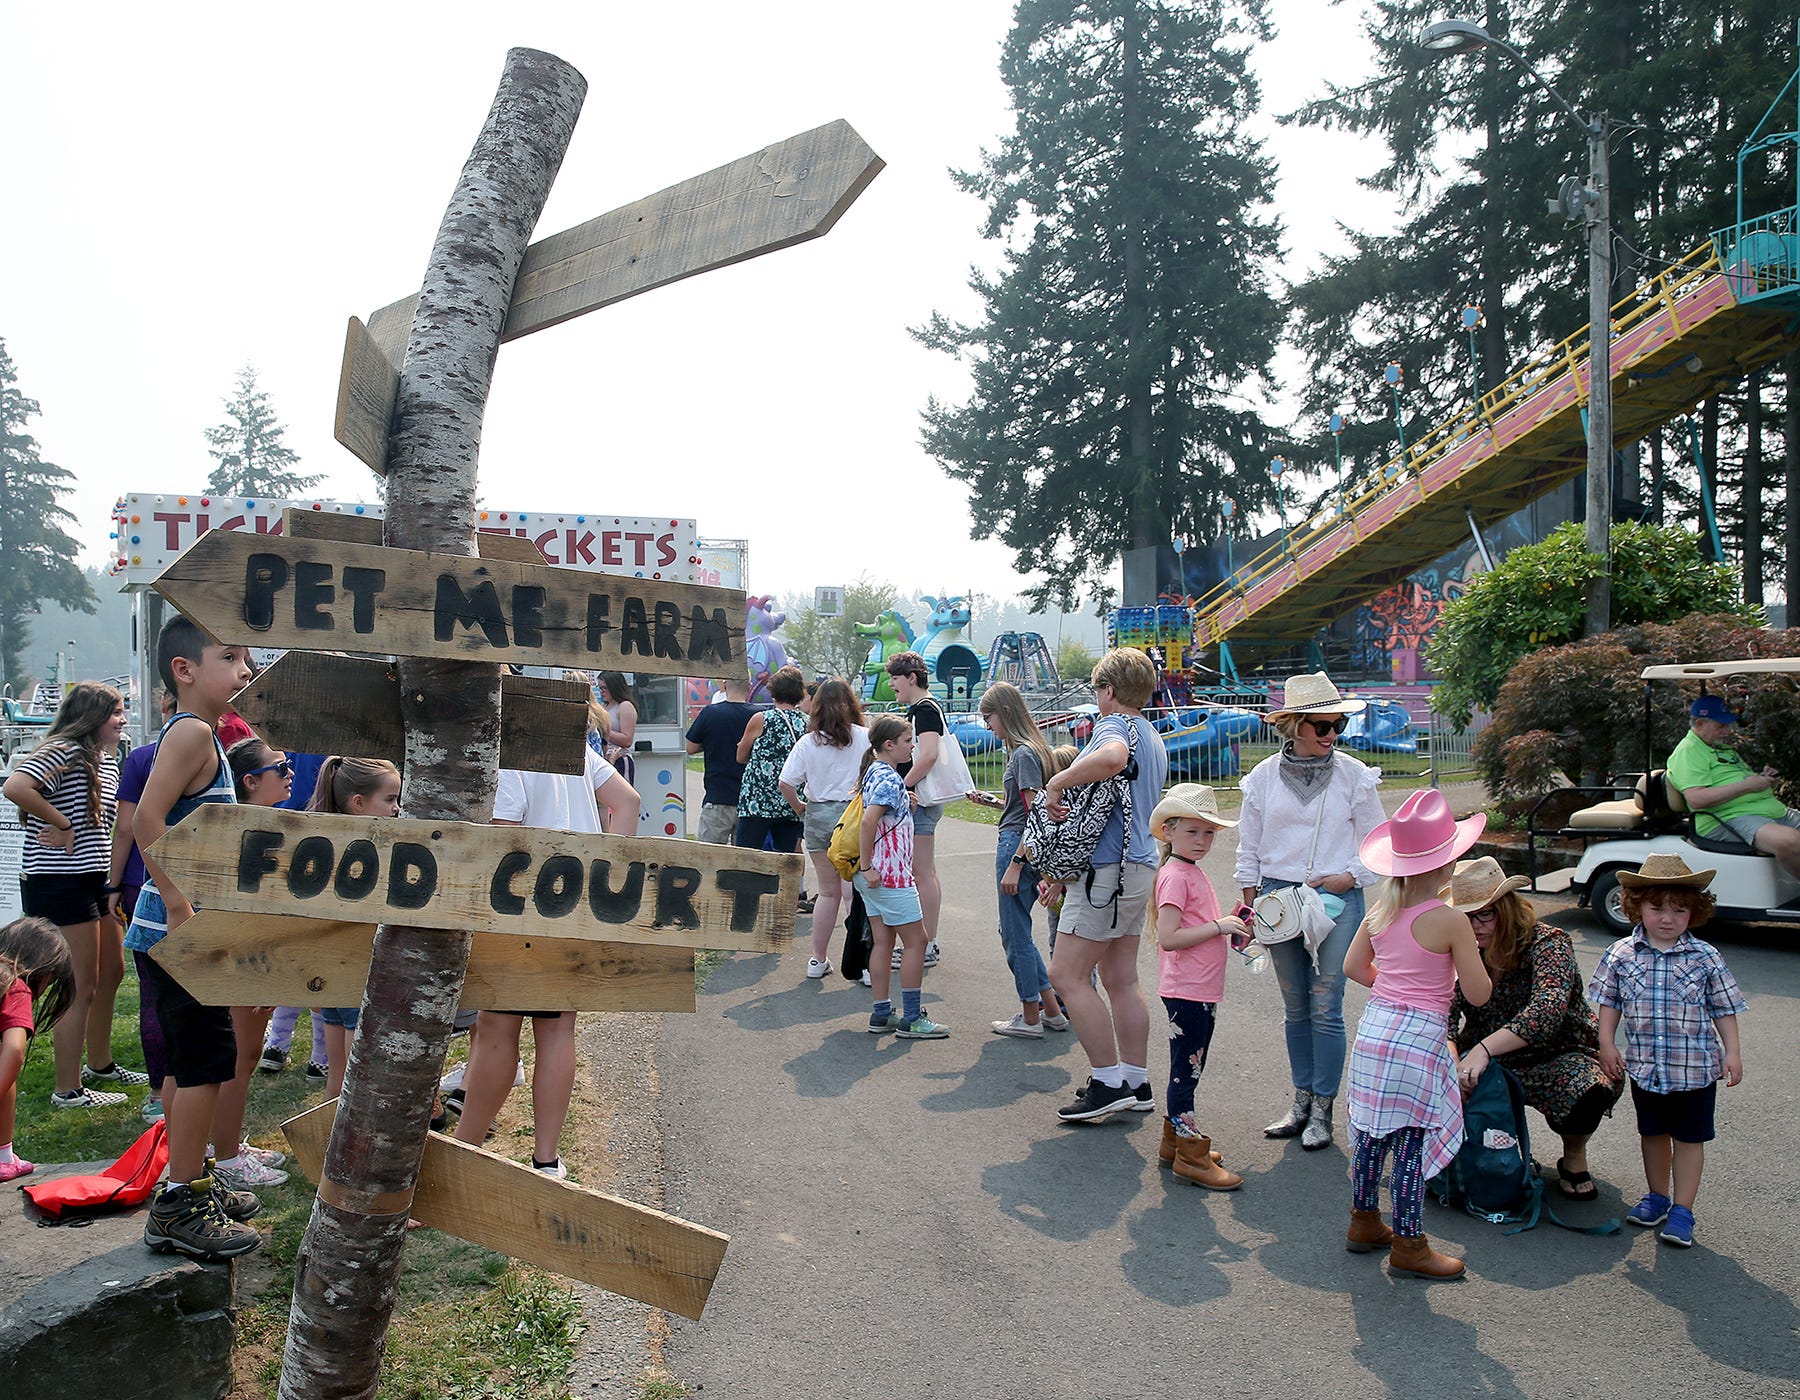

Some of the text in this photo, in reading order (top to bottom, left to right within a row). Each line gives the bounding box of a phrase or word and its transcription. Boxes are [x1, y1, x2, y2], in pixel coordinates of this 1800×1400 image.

[479, 527, 677, 567] CKETS
[245, 553, 732, 662] PET ME FARM
[237, 830, 780, 933] FOOD COURT
